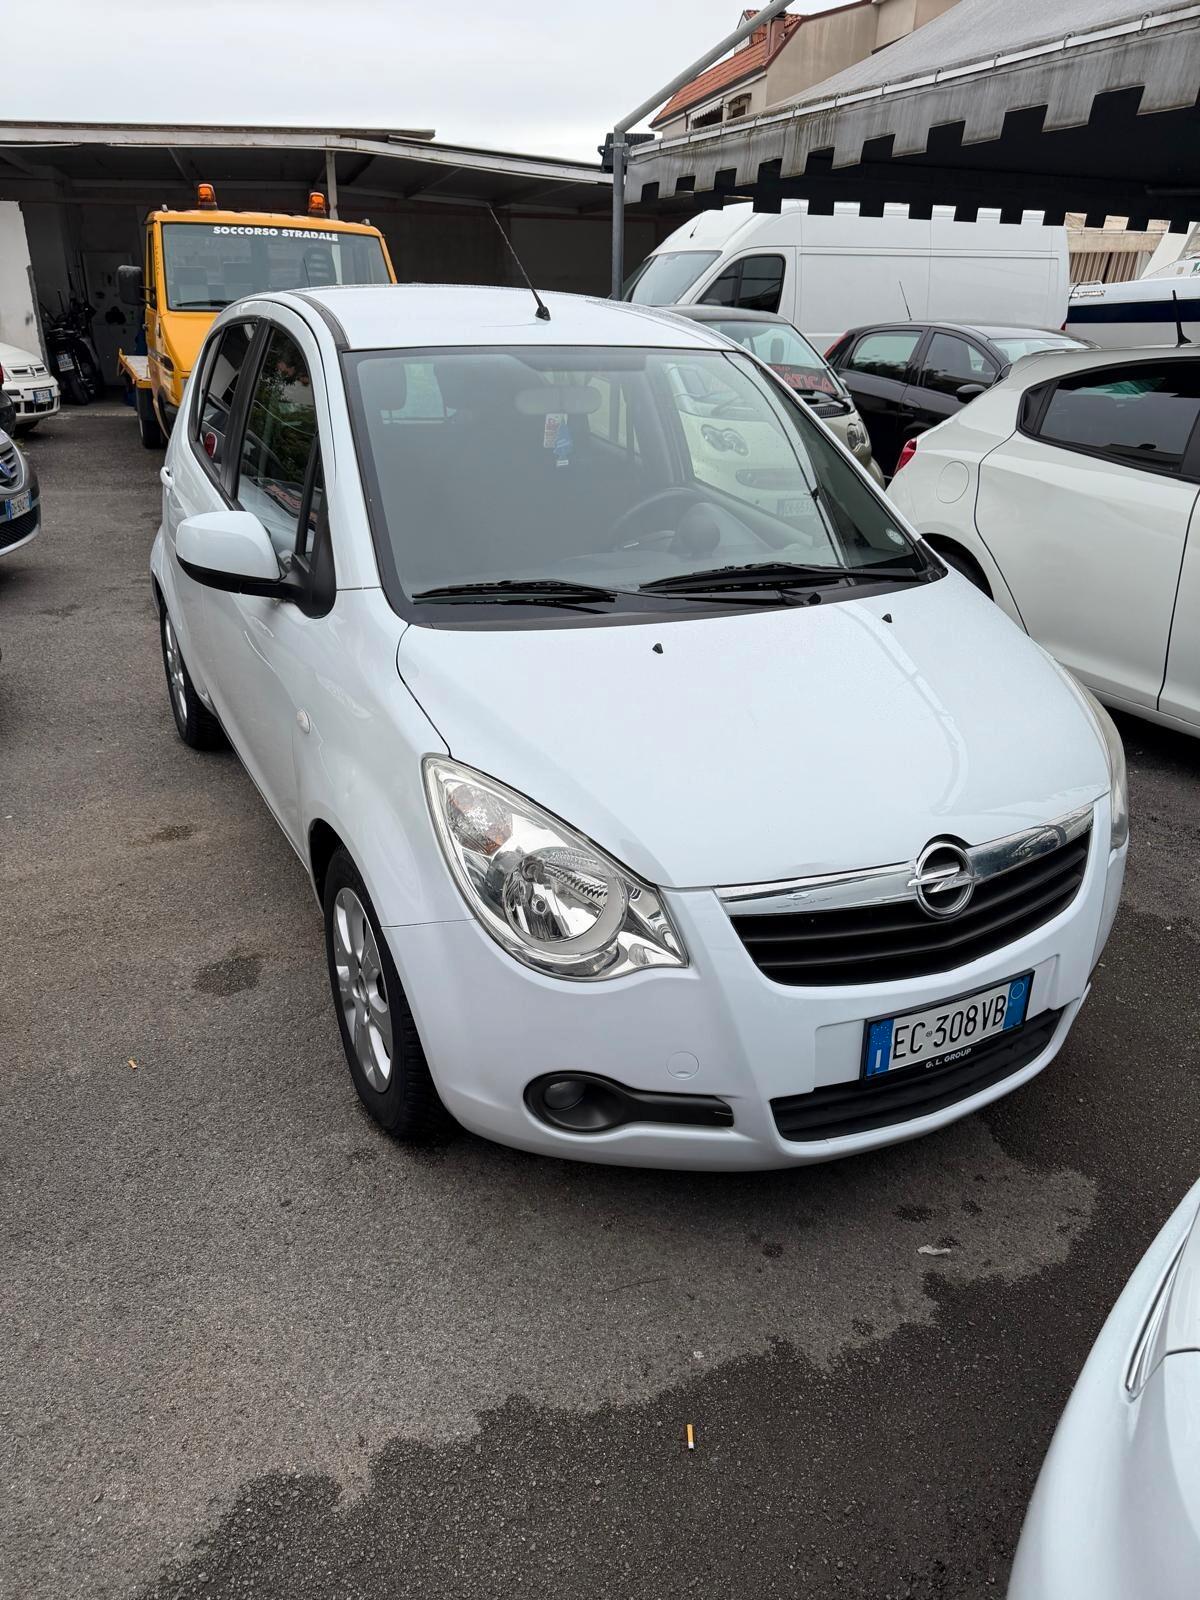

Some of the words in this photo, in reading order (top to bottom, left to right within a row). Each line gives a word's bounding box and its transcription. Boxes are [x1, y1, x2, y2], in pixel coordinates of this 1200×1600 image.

[213, 226, 278, 236] SOCCORSO
[281, 229, 339, 241] STRADALE
[944, 1047, 972, 1062] GROUP
